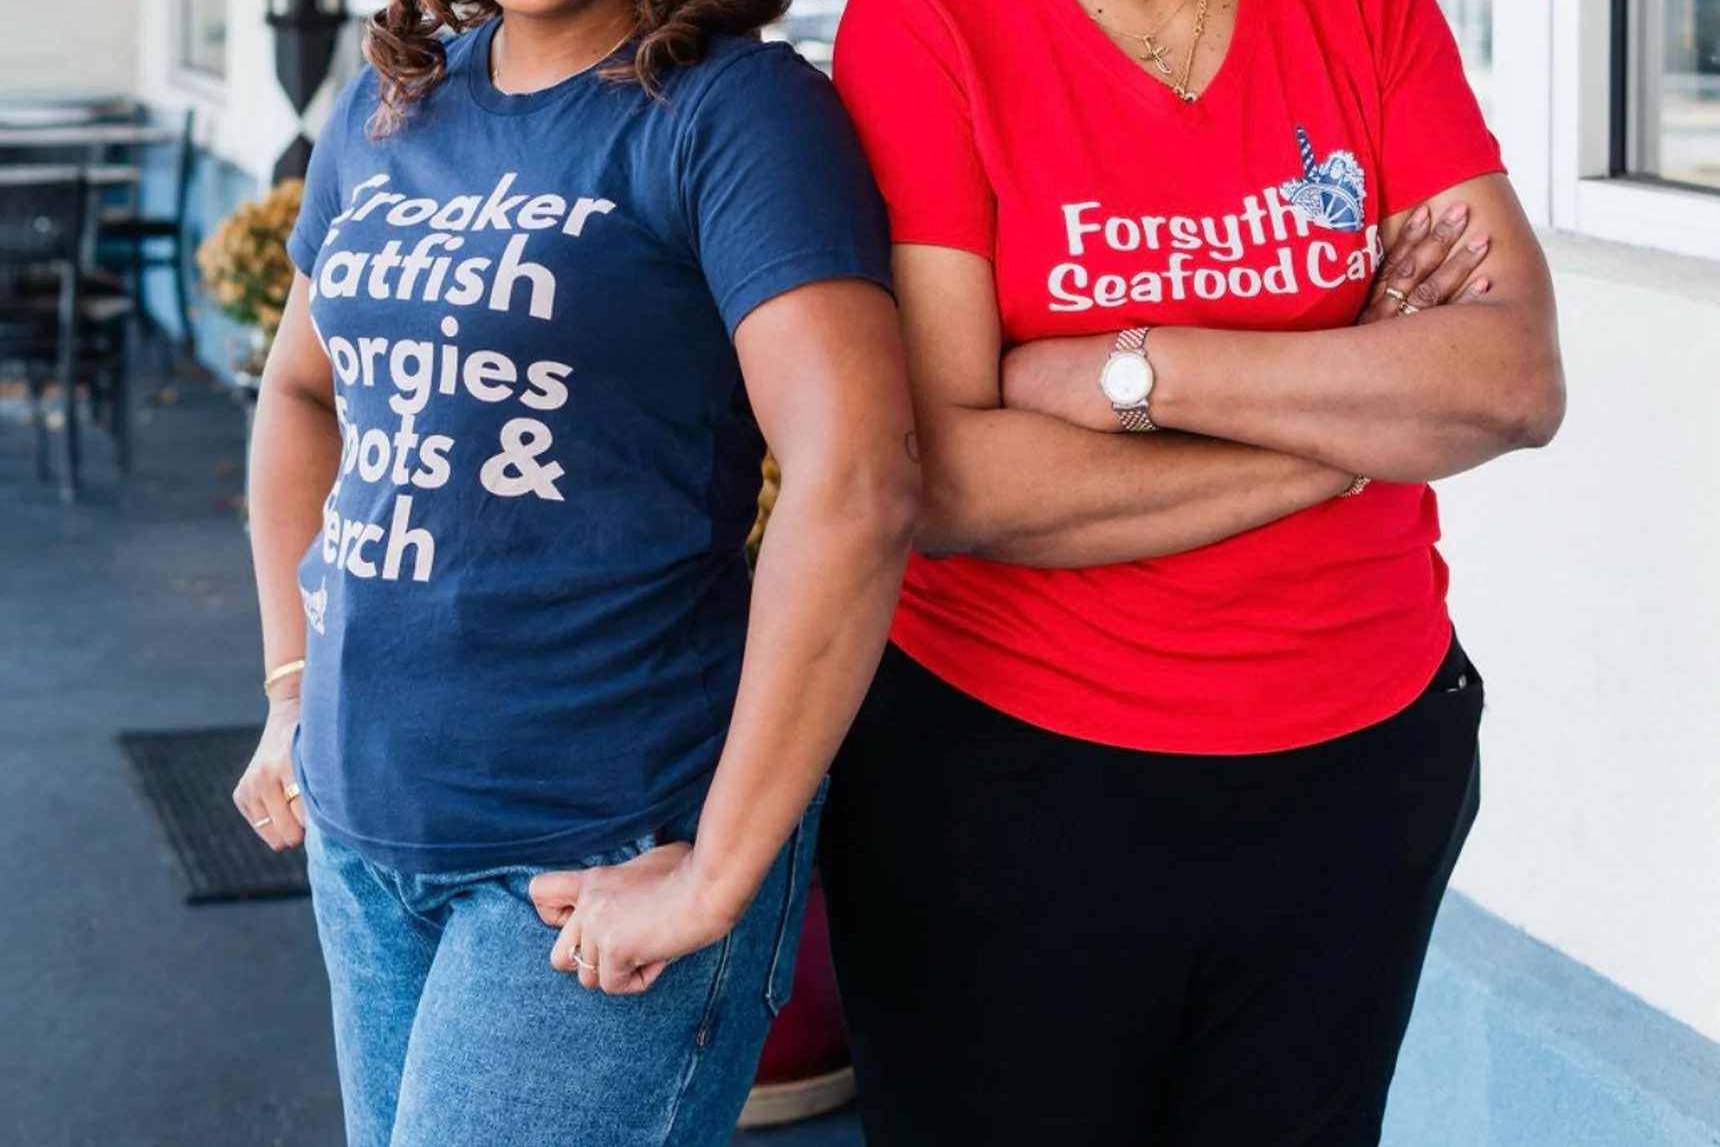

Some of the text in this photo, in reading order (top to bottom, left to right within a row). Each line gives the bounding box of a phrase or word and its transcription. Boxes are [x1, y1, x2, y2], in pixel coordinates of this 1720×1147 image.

[1061, 187, 1310, 262] Forsyth
[1047, 247, 1298, 312] Seafood
[311, 316, 573, 414] orgies
[480, 417, 565, 501] &
